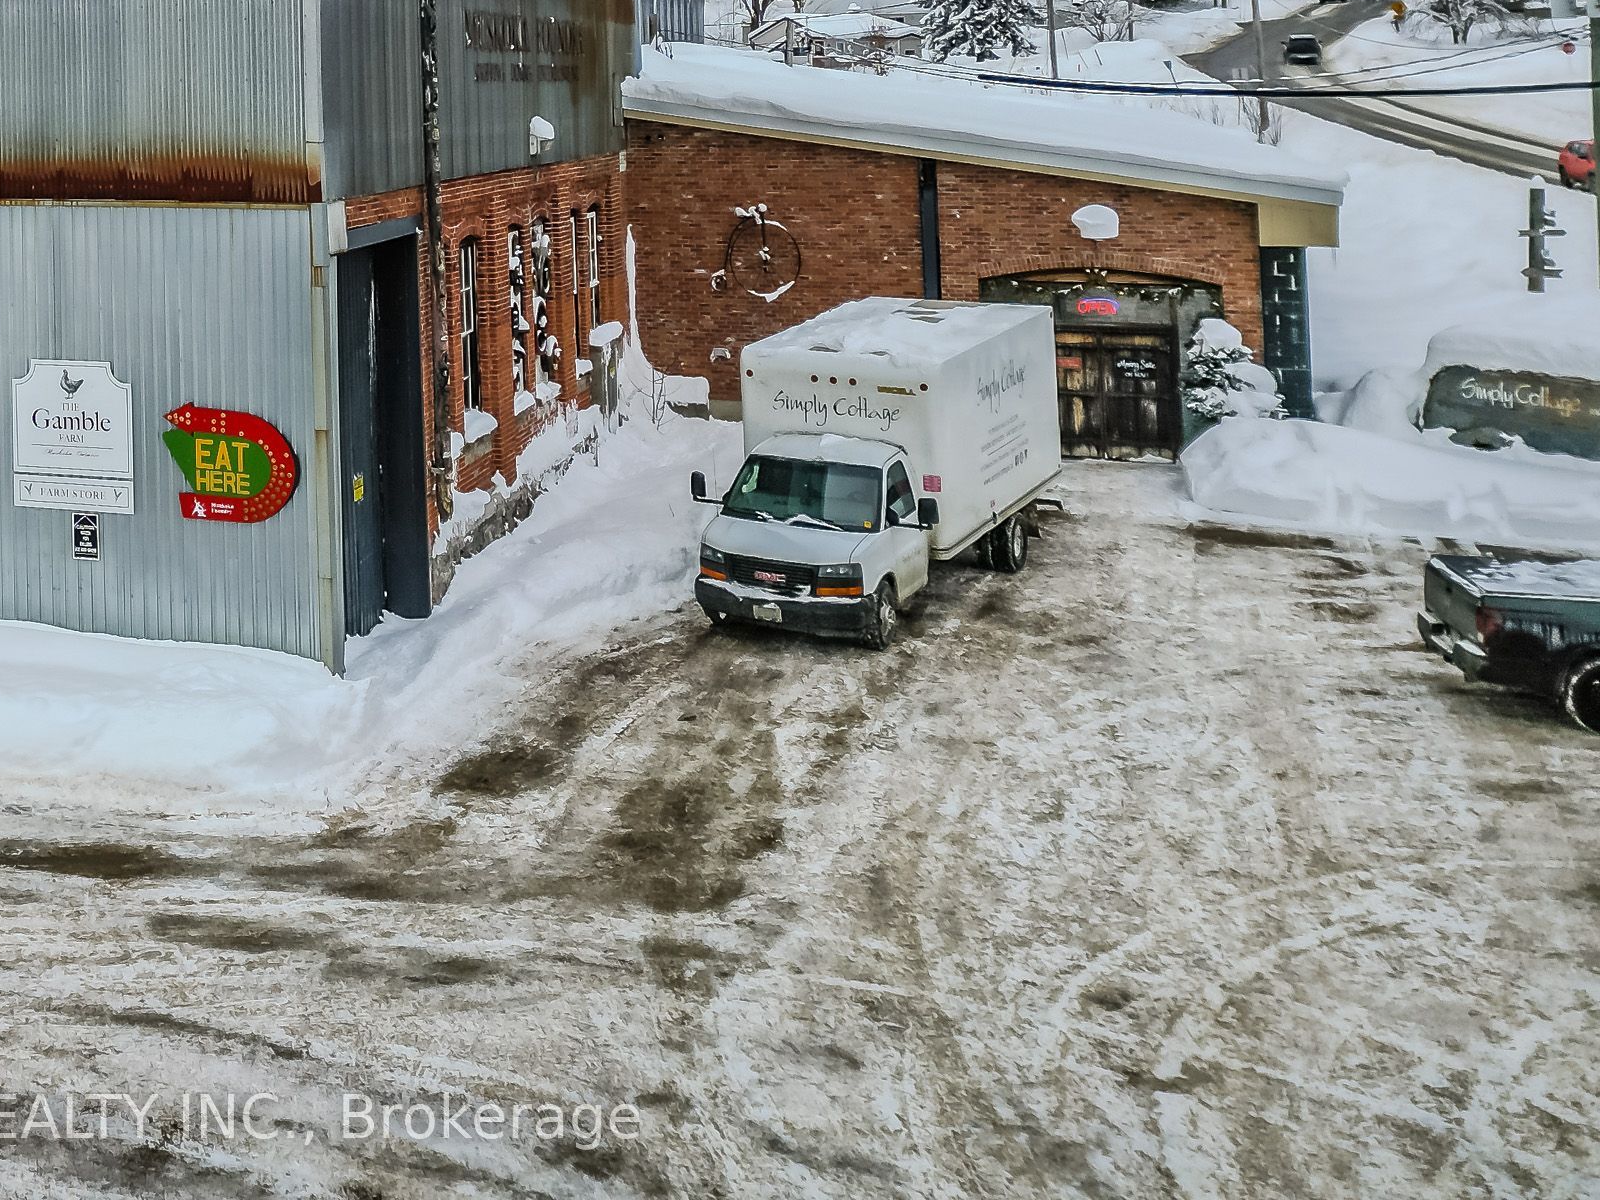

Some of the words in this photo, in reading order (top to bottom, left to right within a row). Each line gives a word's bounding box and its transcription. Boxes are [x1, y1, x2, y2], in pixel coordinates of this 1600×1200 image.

[1460, 377, 1514, 409] Simply
[31, 407, 112, 432] Gamble
[772, 390, 828, 427] Simply
[833, 396, 900, 432] Cottage
[59, 433, 84, 444] FARM
[195, 438, 250, 473] EAT
[40, 487, 69, 498] FARM
[195, 467, 250, 496] HERE
